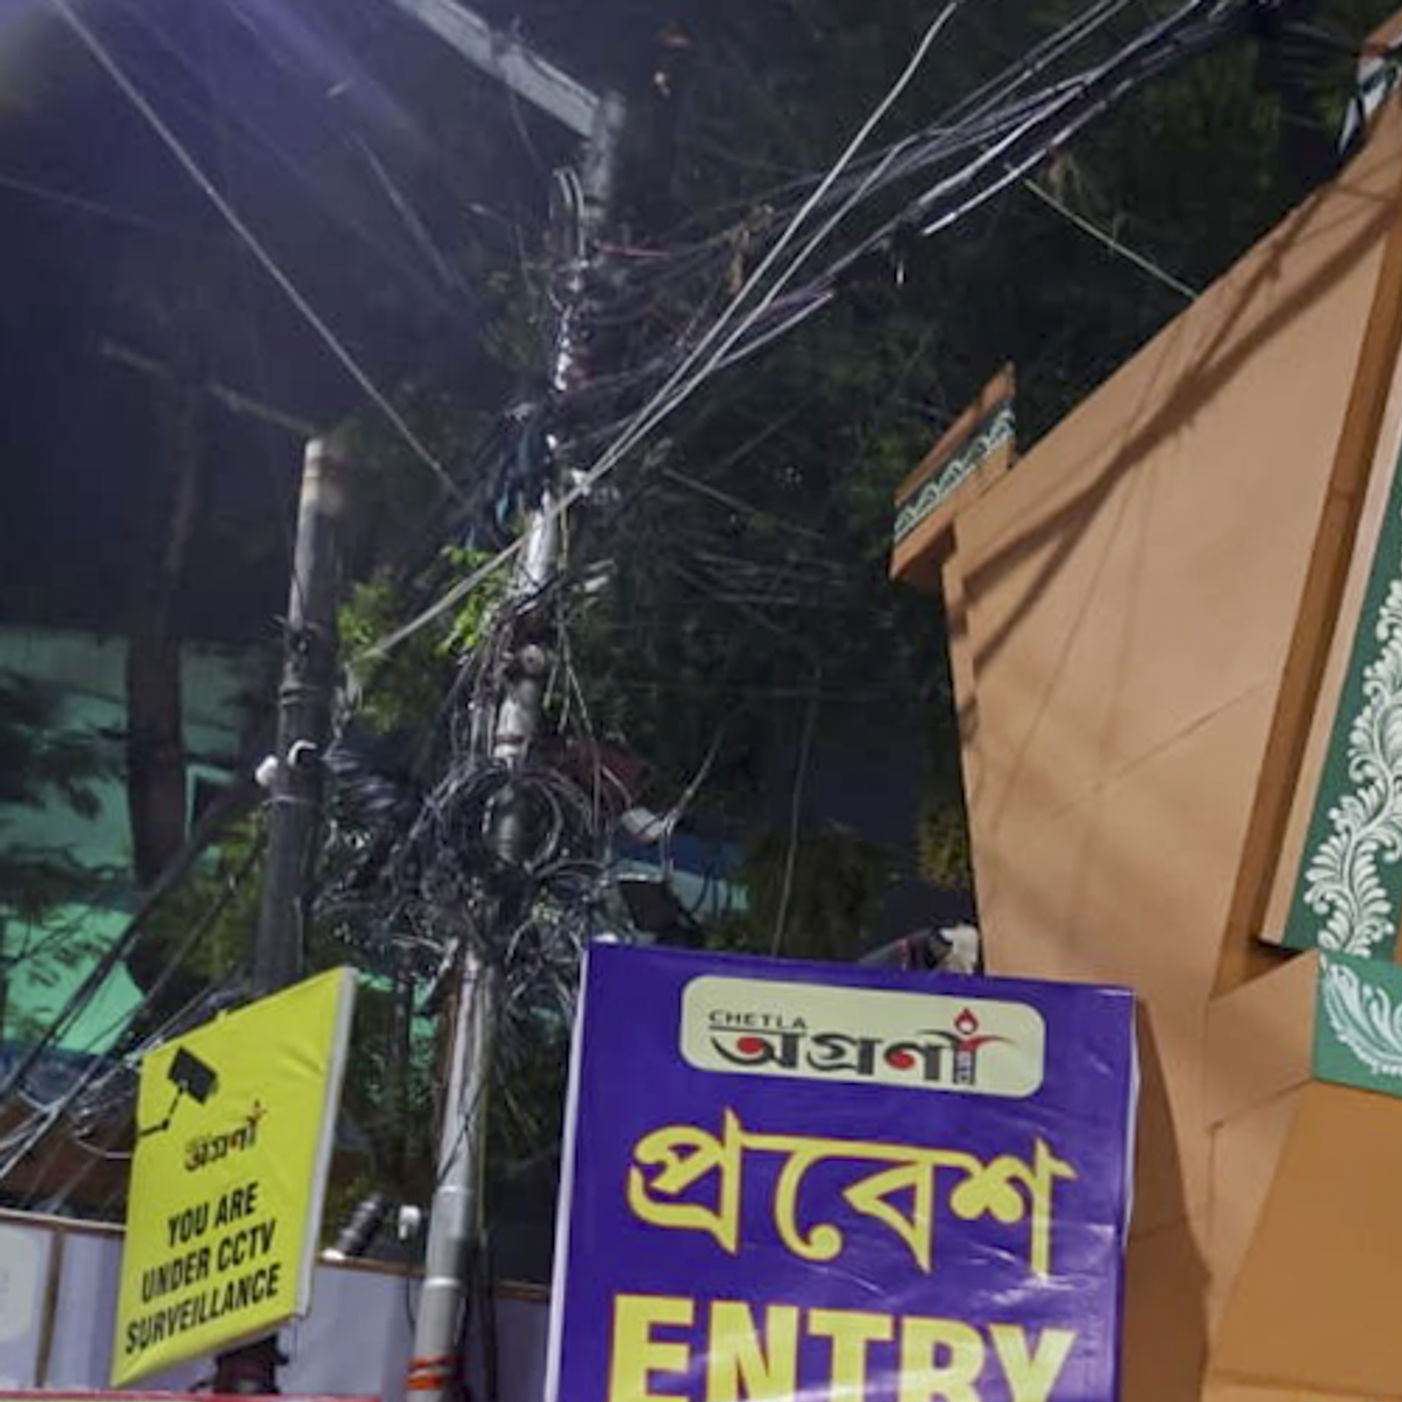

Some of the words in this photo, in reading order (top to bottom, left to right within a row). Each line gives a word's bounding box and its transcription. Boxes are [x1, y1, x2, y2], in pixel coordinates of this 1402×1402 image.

[708, 1009, 807, 1029] CHETLA
[168, 1202, 210, 1248] YOU
[214, 1181, 260, 1229] ARE
[626, 1105, 1076, 1281] প্রবেশ
[141, 1246, 210, 1303] UNDER
[216, 1217, 277, 1272] CCTV
[125, 1262, 282, 1356] SURVEILLANCE
